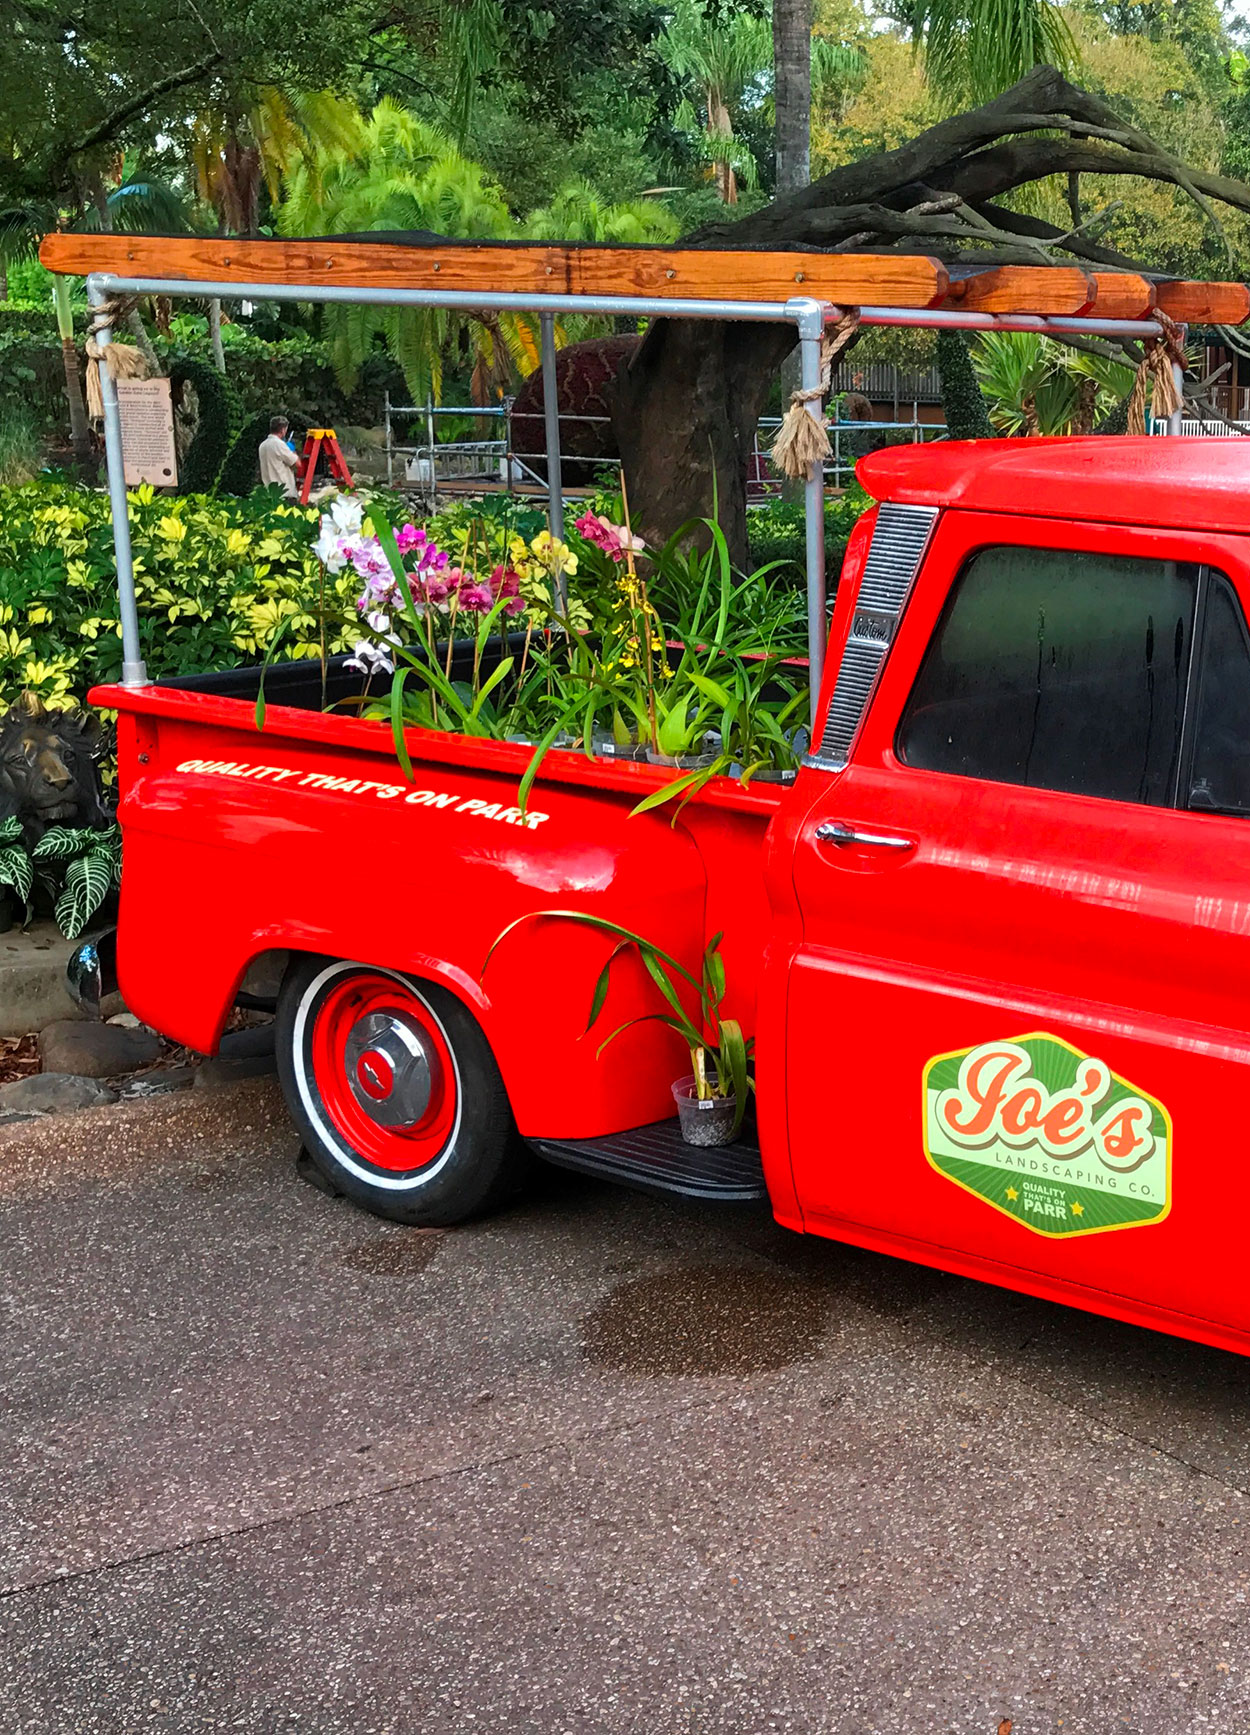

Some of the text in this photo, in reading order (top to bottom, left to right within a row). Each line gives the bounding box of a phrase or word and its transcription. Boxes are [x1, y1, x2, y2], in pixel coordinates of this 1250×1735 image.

[176, 758, 550, 830] QUALITY THAT'S ON PARR
[944, 1051, 1145, 1159] Joe's
[995, 1152, 1155, 1197] LANDSCAPING CO.
[1022, 1182, 1066, 1199] QUALITY
[1023, 1191, 1066, 1207] THAT'S ON
[1023, 1199, 1067, 1220] PARR
